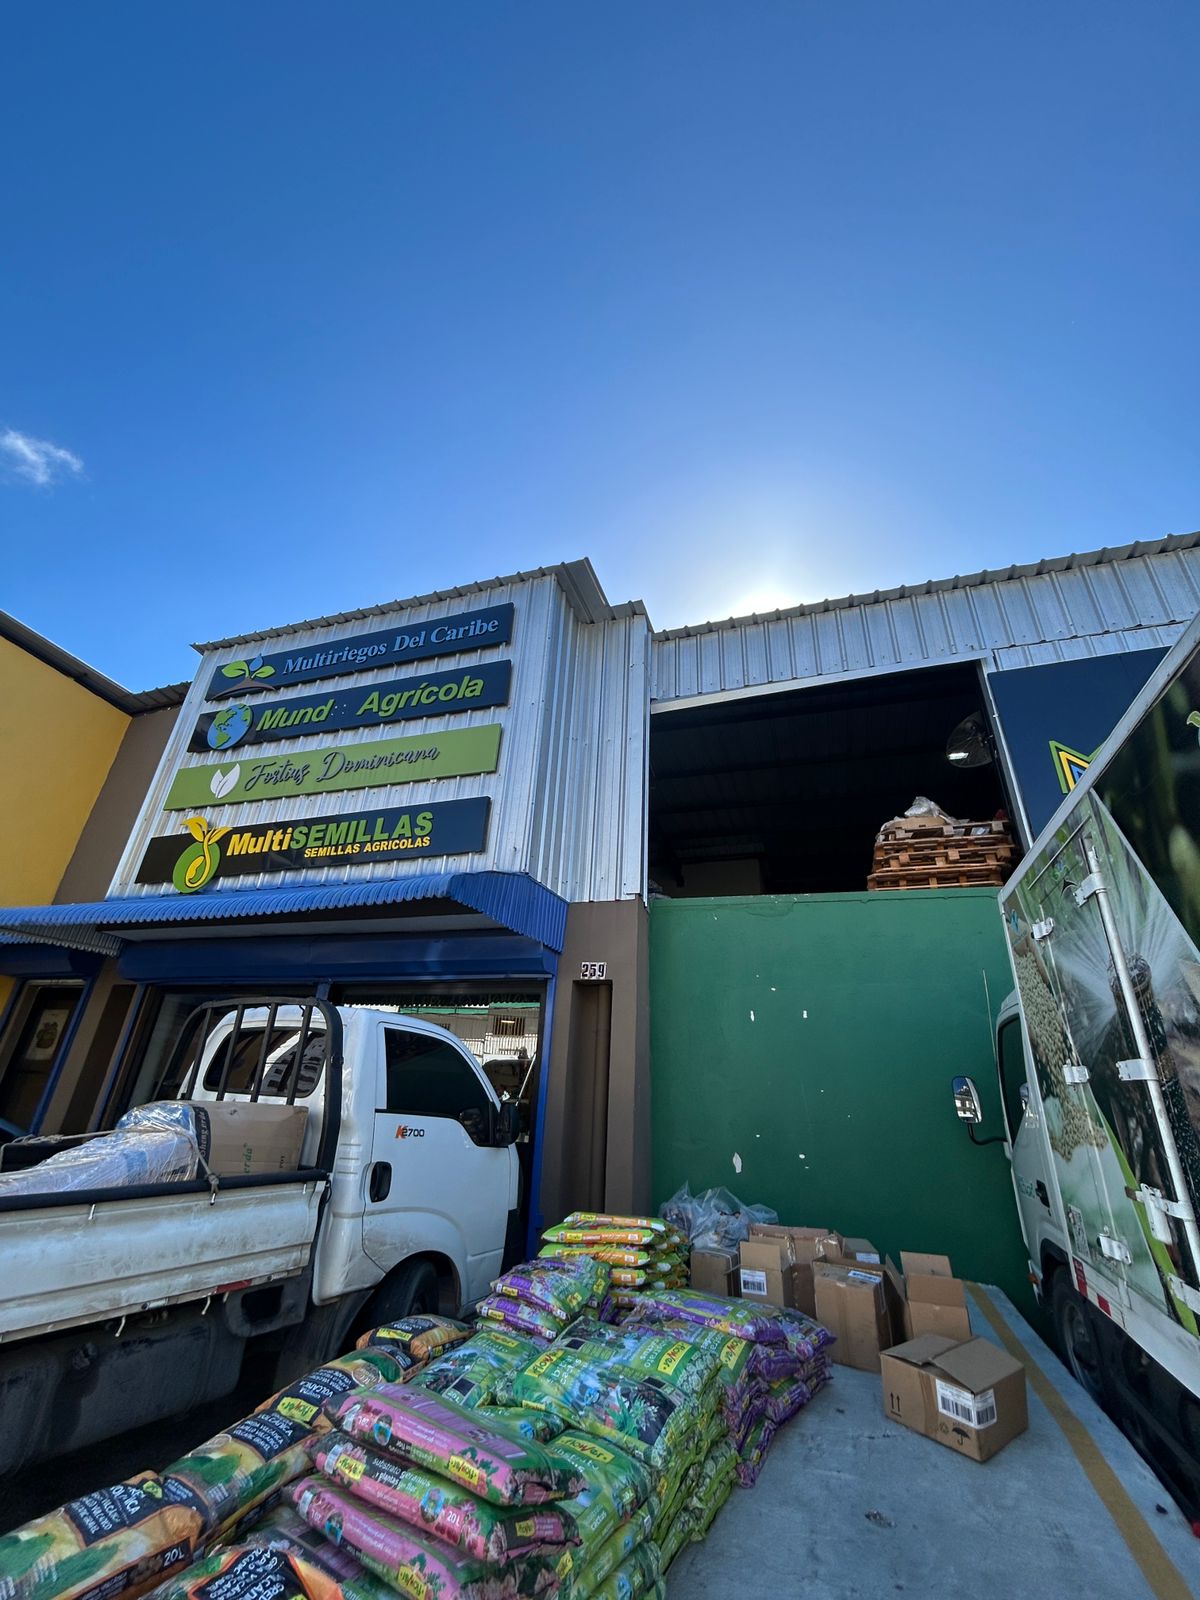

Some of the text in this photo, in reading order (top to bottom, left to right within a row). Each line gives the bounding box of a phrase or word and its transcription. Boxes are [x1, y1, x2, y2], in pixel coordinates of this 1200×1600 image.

[282, 618, 500, 676] Multiriegos Del Caribe
[355, 675, 485, 717] Agrícola
[226, 811, 434, 857] MultiSEMILLAS
[303, 836, 431, 859] SEMILLAS AGRICOLAS
[581, 962, 606, 978] 259
[395, 1124, 425, 1139] K2700
[372, 1456, 401, 1477] substrato
[163, 1548, 185, 1567] 20L
